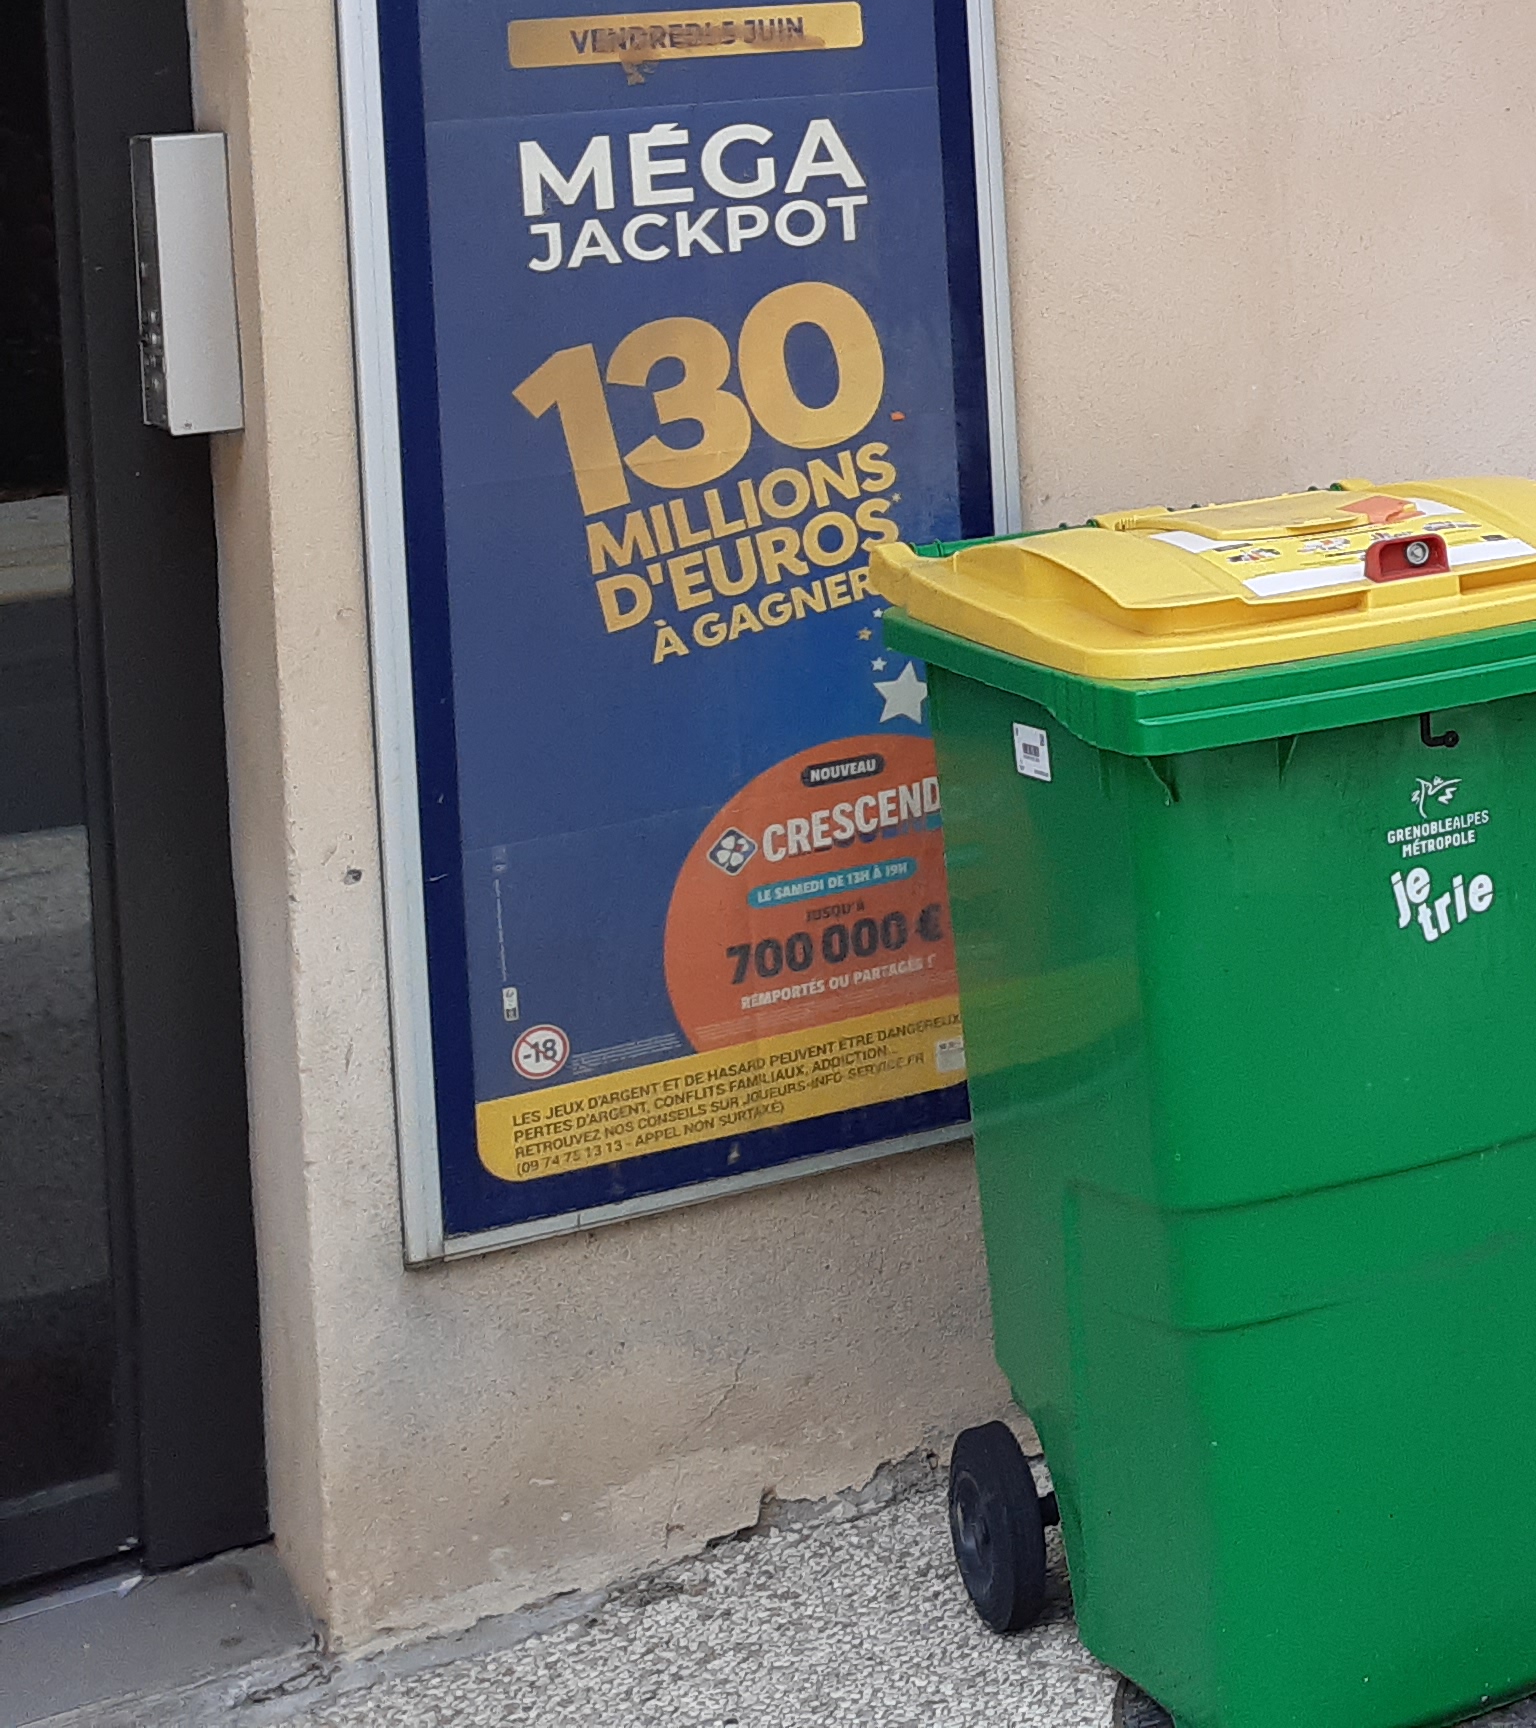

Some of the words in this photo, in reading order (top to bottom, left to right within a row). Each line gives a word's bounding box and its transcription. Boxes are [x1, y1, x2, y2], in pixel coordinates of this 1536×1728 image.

[744, 16, 804, 43] JUIN
[519, 119, 867, 217] MÉGA
[529, 195, 869, 271] JACKPOT
[512, 281, 885, 517] 130
[586, 441, 897, 575] MILLIONS
[596, 498, 899, 633] D'EUROS
[652, 619, 689, 663] À
[692, 568, 879, 650] GAGNER
[810, 759, 876, 782] NOUVEAU
[1402, 830, 1476, 858] MÉTROPOLE
[757, 889, 772, 903] LE
[775, 878, 824, 900] SAMEDI
[828, 876, 844, 889] DE
[846, 871, 870, 886] 13H
[1391, 867, 1431, 929] je
[1417, 874, 1494, 942] trie
[727, 931, 813, 985] 700
[822, 911, 908, 965] 000
[917, 903, 944, 942] €
[741, 975, 825, 1010] REMPORTÉS
[829, 971, 850, 990] OU
[512, 1110, 541, 1128] LES
[545, 1099, 584, 1121] JEUX
[588, 1082, 658, 1112] D'ARGENT
[663, 1077, 680, 1092] ET
[685, 1071, 705, 1088] DE
[708, 1058, 765, 1082] HASARD
[769, 1041, 834, 1067] PEUVENT
[513, 1119, 572, 1144] PERTES
[654, 1084, 726, 1110] CONFLITS
[514, 1129, 602, 1160] RETROUVEZ
[604, 1121, 634, 1139] NOS
[638, 1103, 707, 1131] CONSEILS
[711, 1096, 739, 1114] SUR
[544, 1154, 560, 1169] 74
[634, 1126, 681, 1148] APPEL
[684, 1116, 715, 1137] NON
